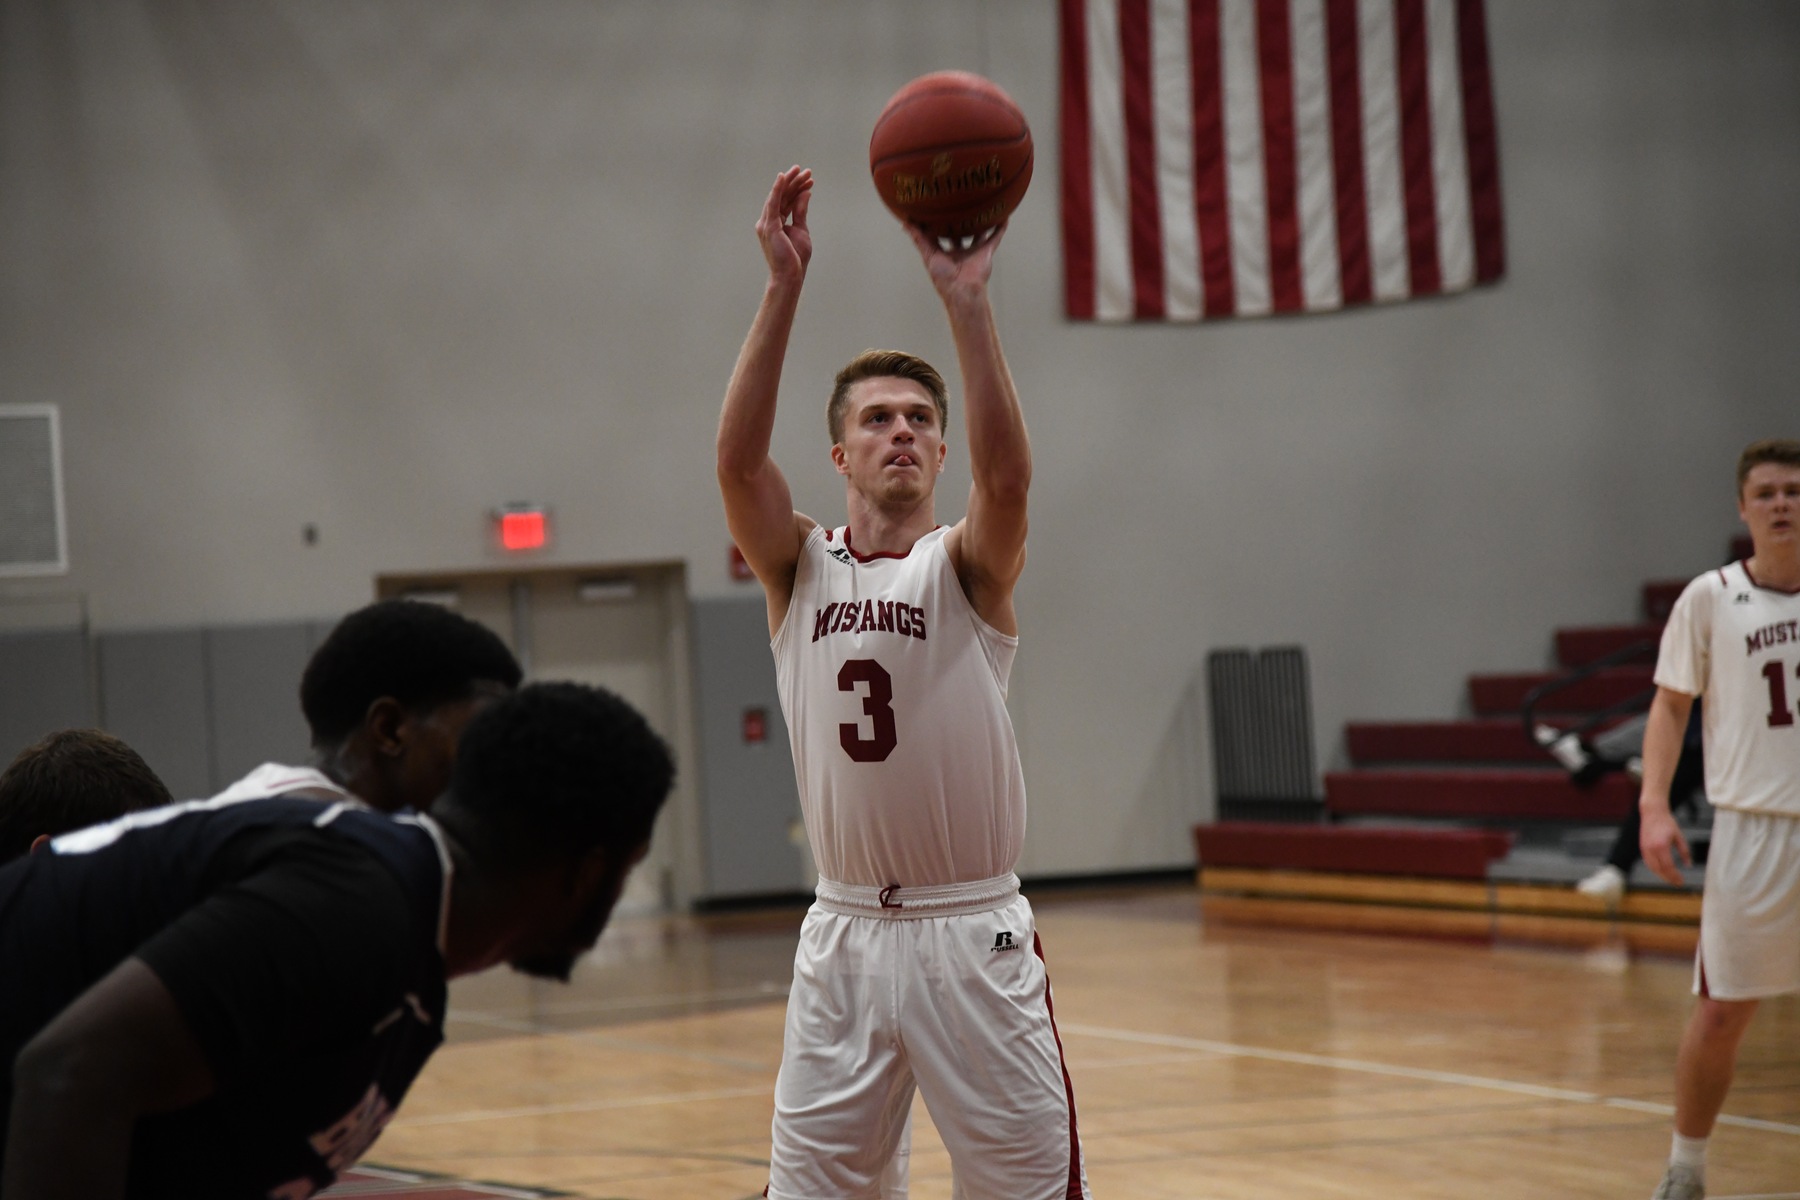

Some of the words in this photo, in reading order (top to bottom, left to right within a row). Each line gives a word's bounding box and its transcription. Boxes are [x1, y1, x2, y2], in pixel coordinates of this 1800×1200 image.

[1745, 620, 1800, 656] MUST
[837, 659, 897, 762] 3
[1762, 660, 1800, 728] 1
